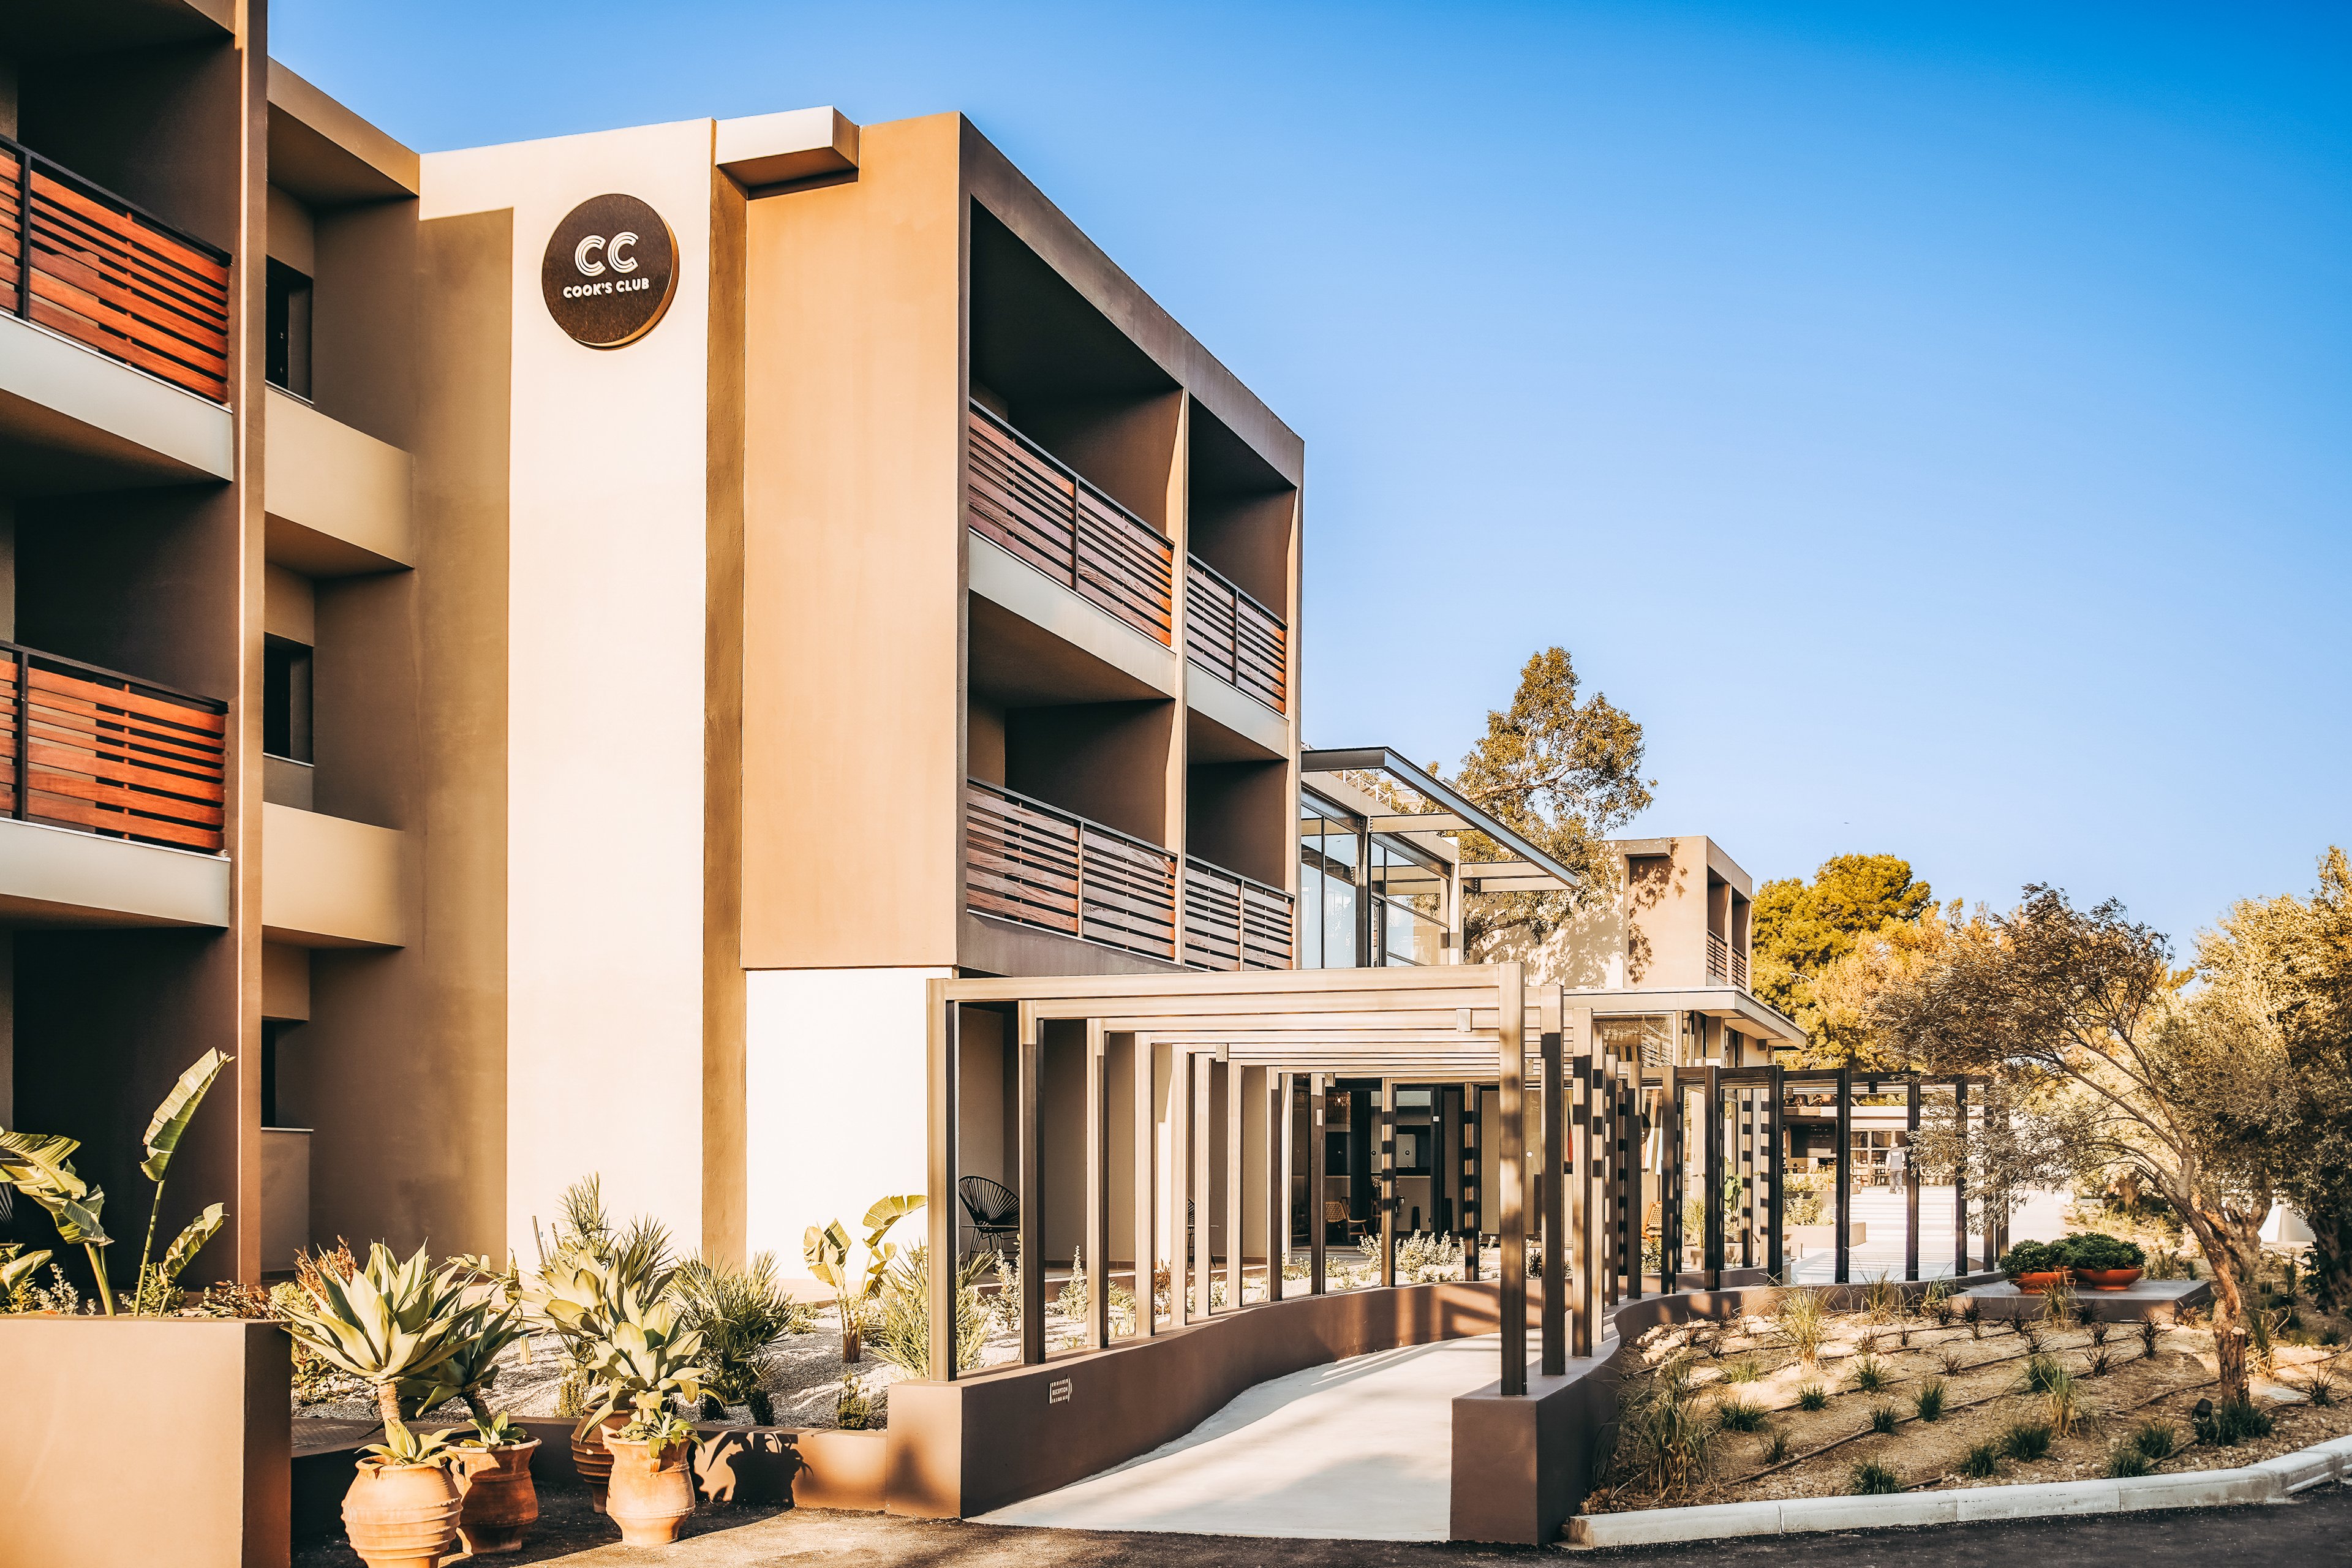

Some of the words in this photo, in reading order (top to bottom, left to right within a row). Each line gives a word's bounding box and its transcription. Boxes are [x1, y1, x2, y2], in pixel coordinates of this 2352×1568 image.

[574, 231, 639, 277] CC
[563, 282, 612, 298] COOK'S
[616, 277, 649, 293] CLUB
[1052, 1386, 1068, 1396] RECEPTION
